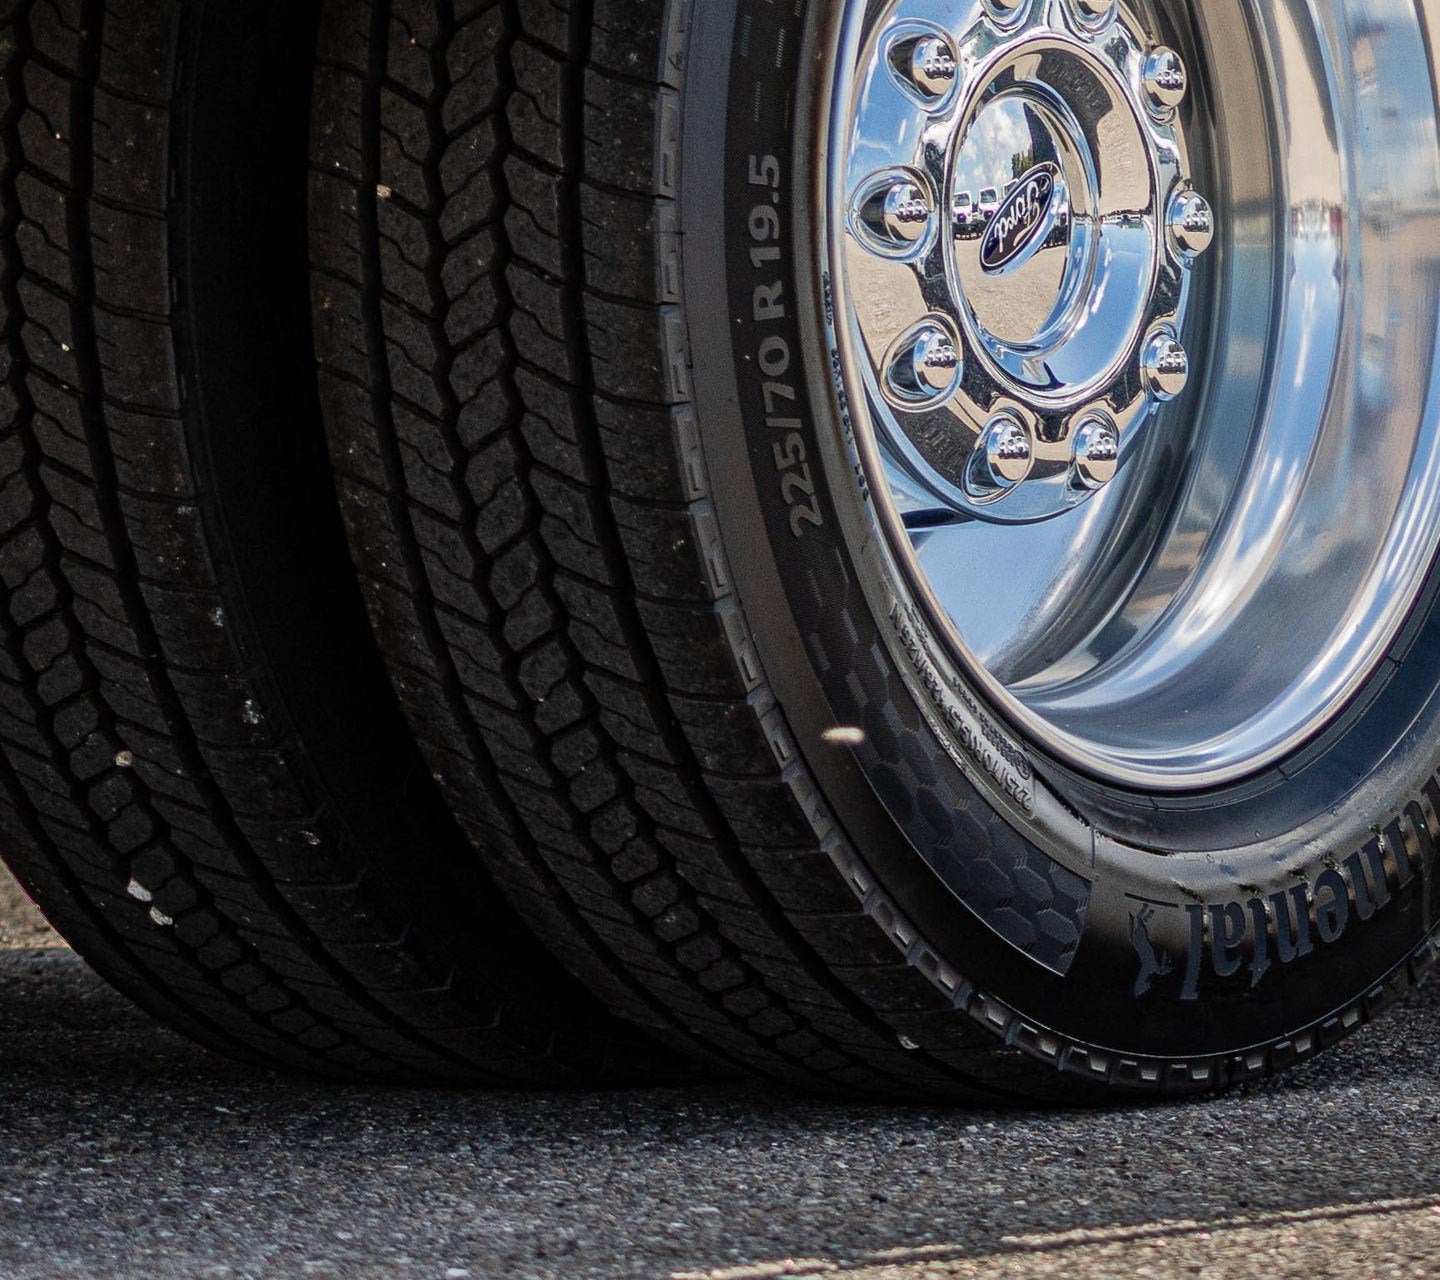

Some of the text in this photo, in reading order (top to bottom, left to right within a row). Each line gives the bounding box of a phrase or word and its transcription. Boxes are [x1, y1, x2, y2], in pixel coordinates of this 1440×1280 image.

[748, 153, 782, 272] 19.5
[994, 177, 1050, 253] Ford
[758, 336, 825, 538] 225/70
